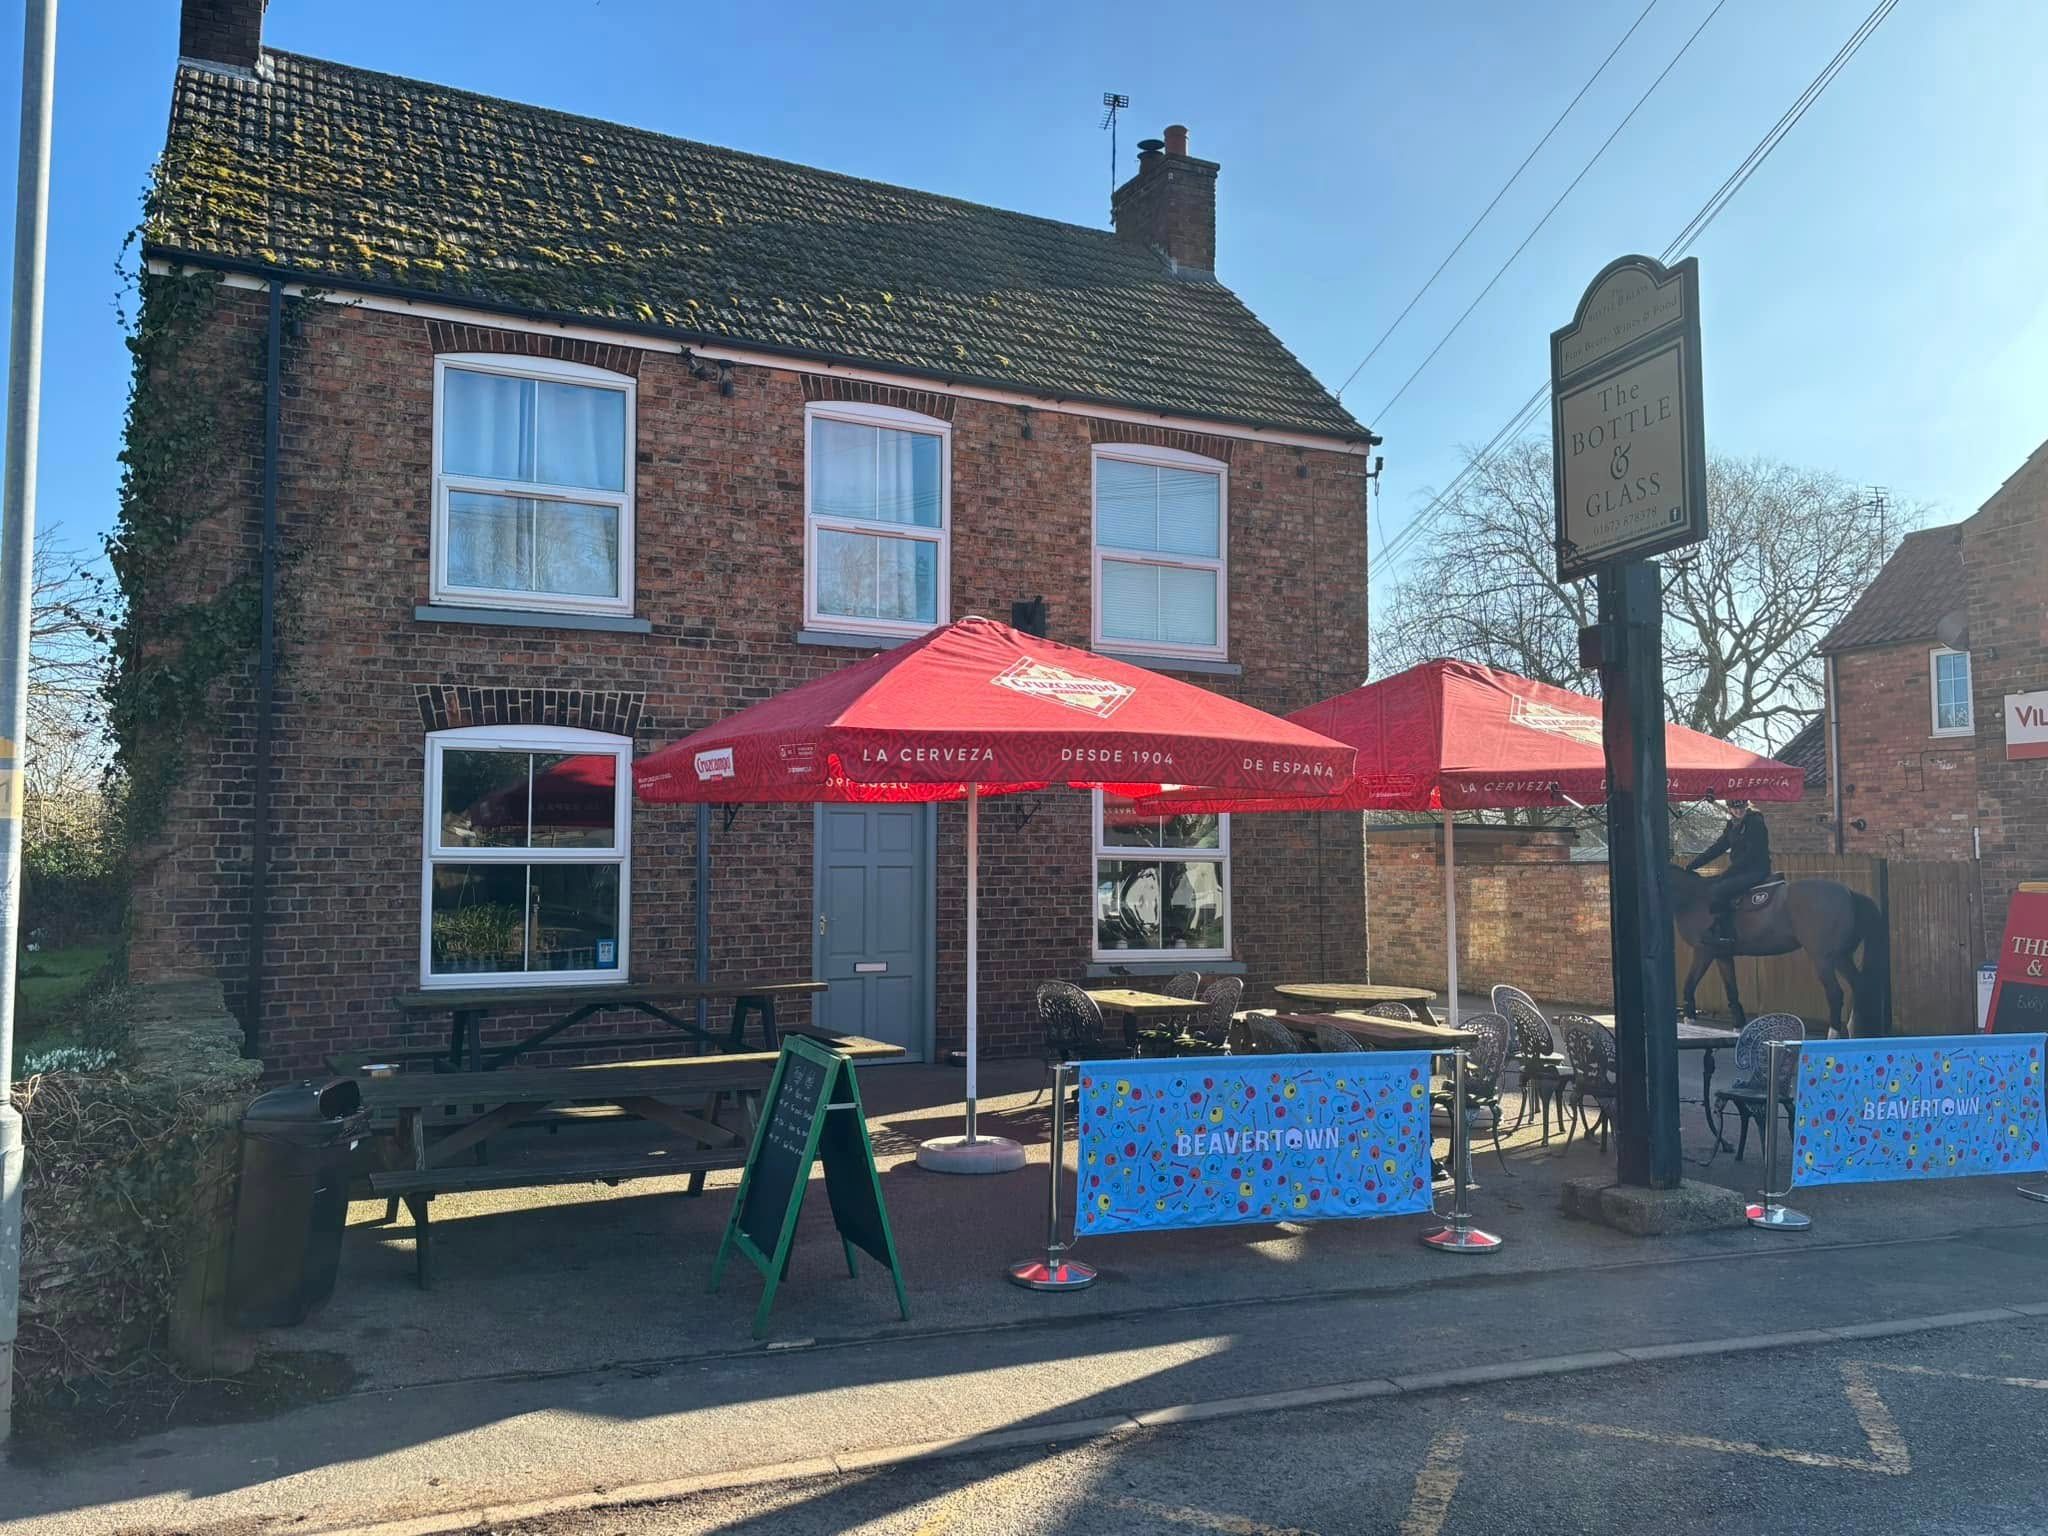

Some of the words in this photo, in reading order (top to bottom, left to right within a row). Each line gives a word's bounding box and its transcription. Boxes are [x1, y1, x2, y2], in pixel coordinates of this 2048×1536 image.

[1598, 383, 1640, 412] The
[1572, 396, 1672, 456] BOTTLE
[1610, 441, 1632, 480] &
[1586, 472, 1661, 518] GLASS
[863, 748, 888, 762] LA
[900, 747, 995, 762] CERVEZA
[1061, 748, 1123, 763] DESDE
[1132, 751, 1174, 765] 1904
[1243, 758, 1267, 772] DE
[1272, 760, 1334, 778] ESPAÑA
[1460, 783, 1477, 793] LA
[1728, 778, 1744, 789] DE
[2027, 959, 2043, 977] &
[1862, 1097, 1980, 1121] BEAVERTOWN
[1176, 1126, 1340, 1158] BEAVERTOWN
